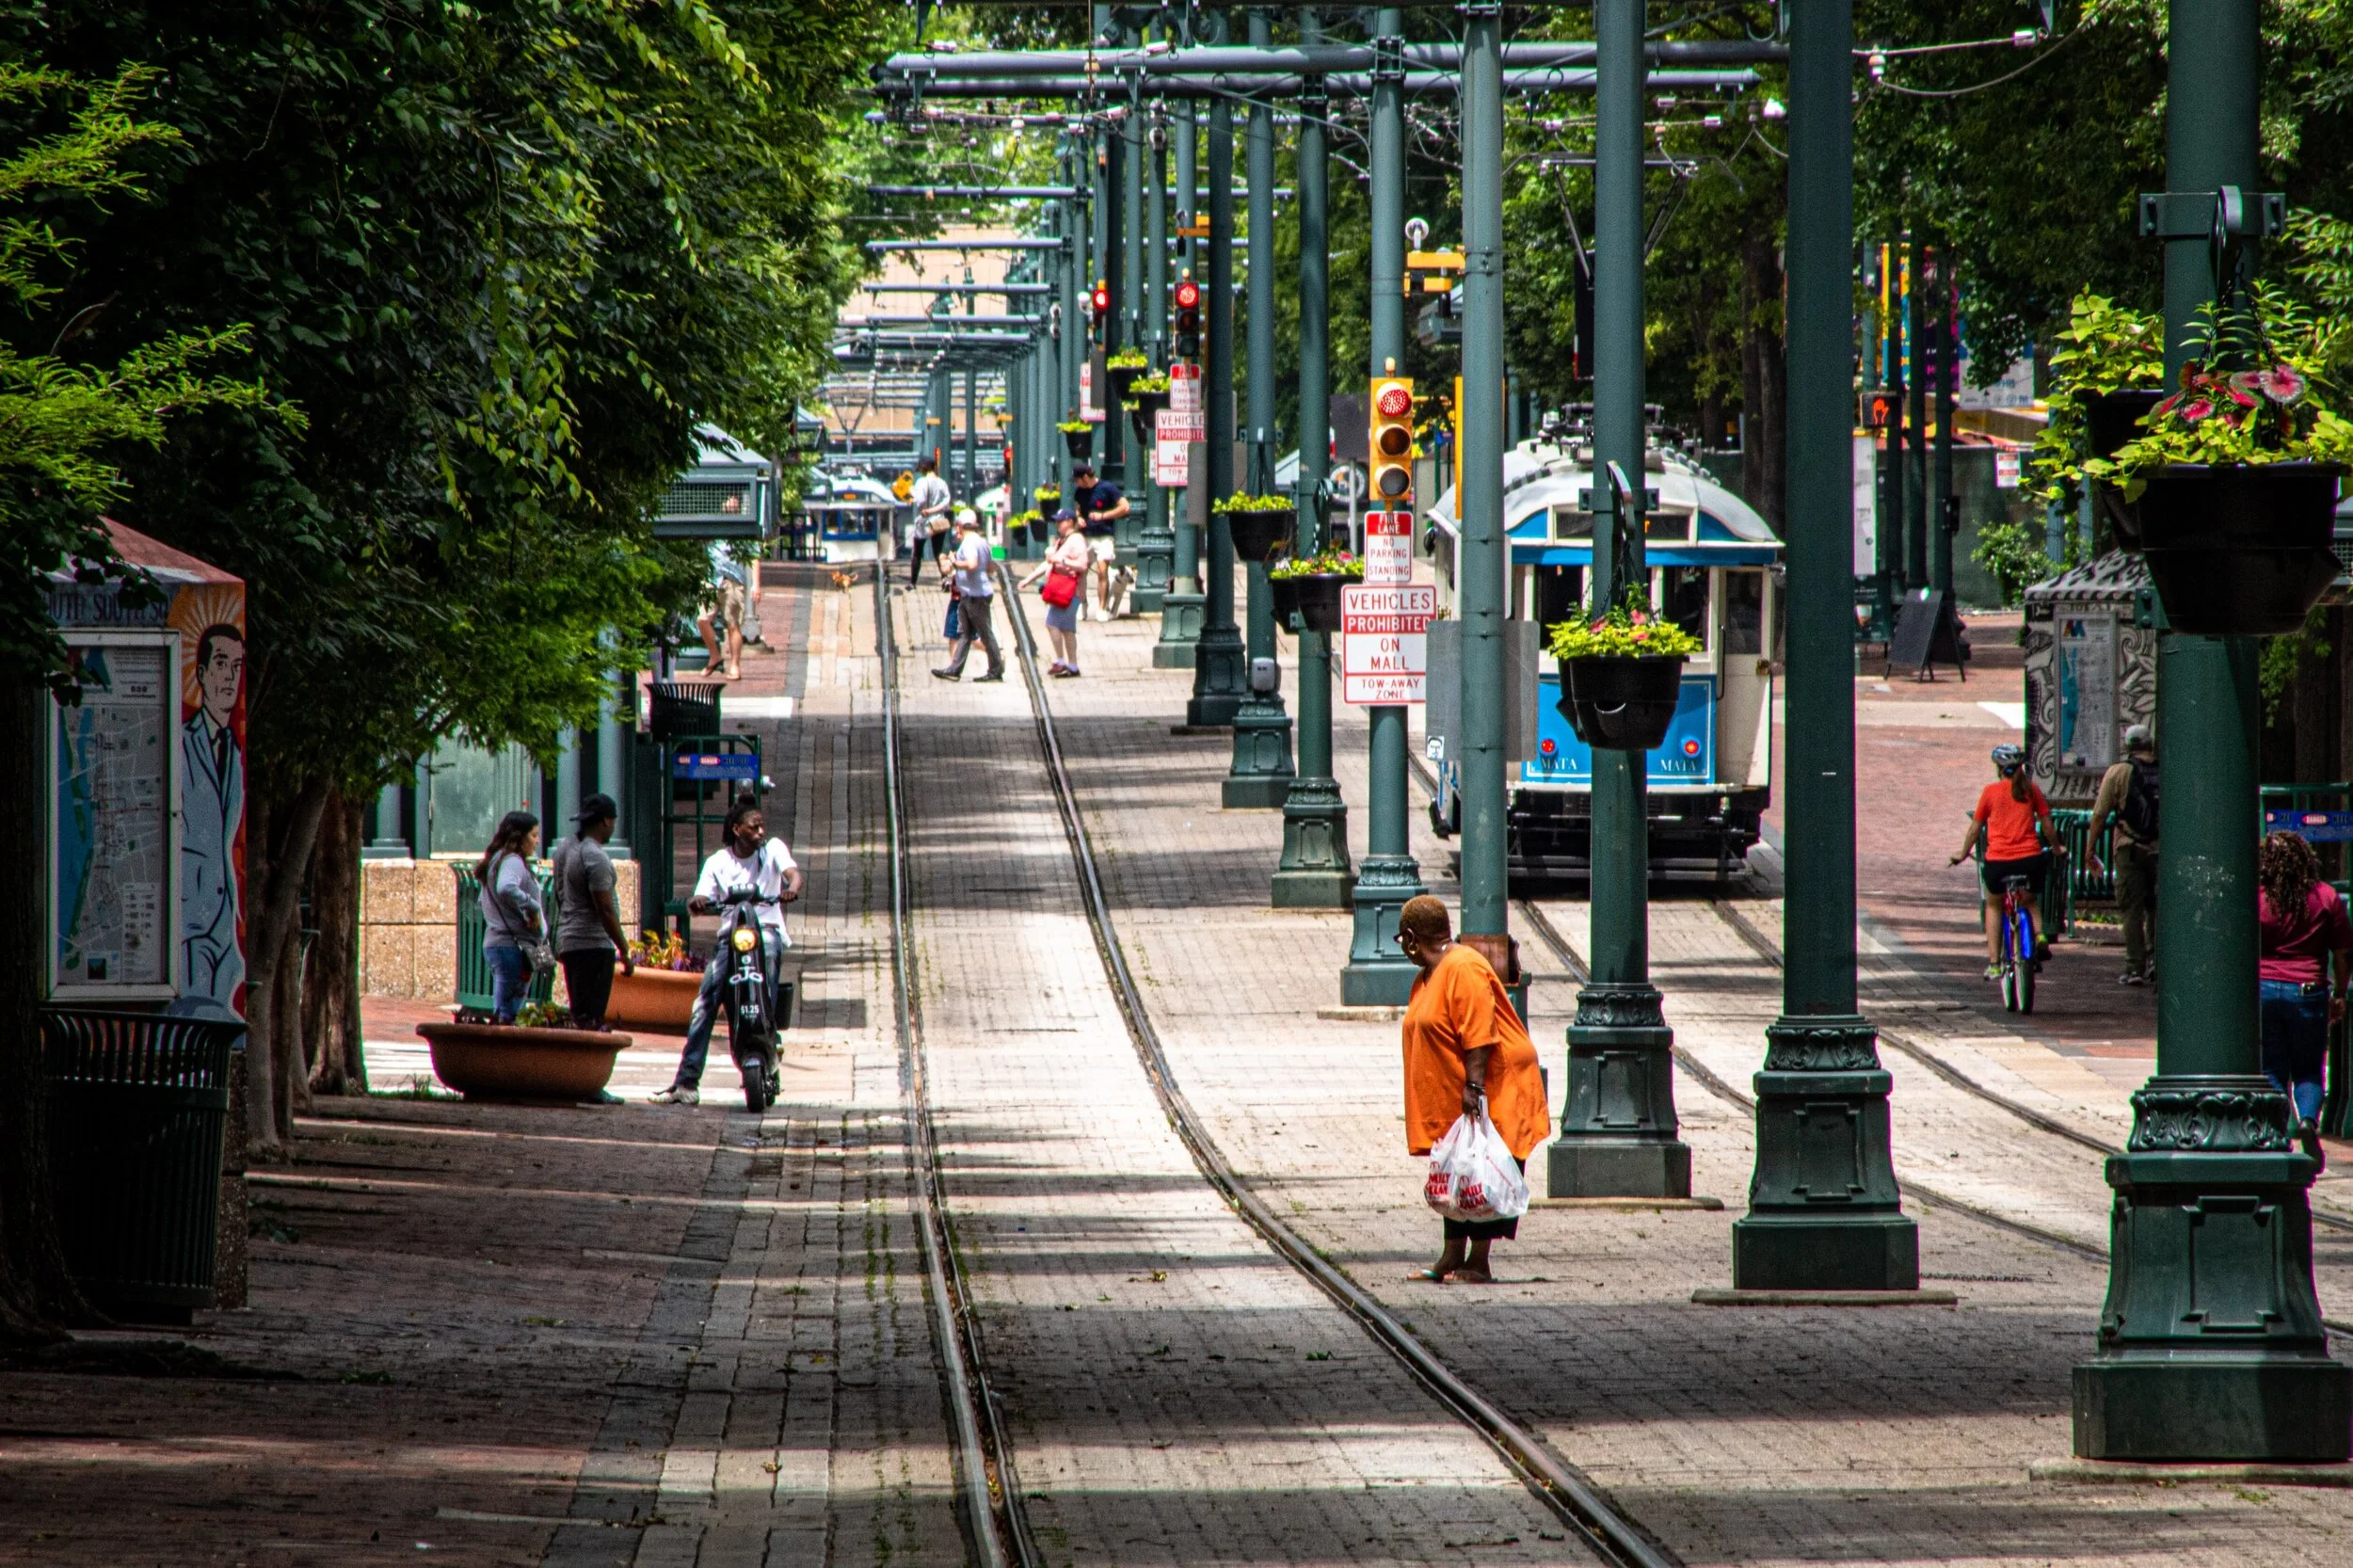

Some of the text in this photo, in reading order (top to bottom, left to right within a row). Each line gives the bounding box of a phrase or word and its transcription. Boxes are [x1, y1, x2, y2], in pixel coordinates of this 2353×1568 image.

[1160, 415, 1204, 425] VEHICLE
[1160, 429, 1205, 440] PROHIBITE
[1175, 455, 1187, 464] MA
[1377, 524, 1401, 535] LANE
[1383, 537, 1395, 547] NO
[1370, 549, 1407, 558] PARKING
[1369, 566, 1409, 576] STANDING
[1350, 593, 1430, 610] VEHICLES
[1348, 616, 1431, 632] PROHIBITED
[1380, 637, 1401, 652] ON
[1370, 655, 1410, 670] MALL
[1376, 690, 1404, 699] ZONE
[1542, 758, 1577, 770] MATA
[1660, 759, 1697, 772] MATA
[741, 1004, 760, 1015] $1.25
